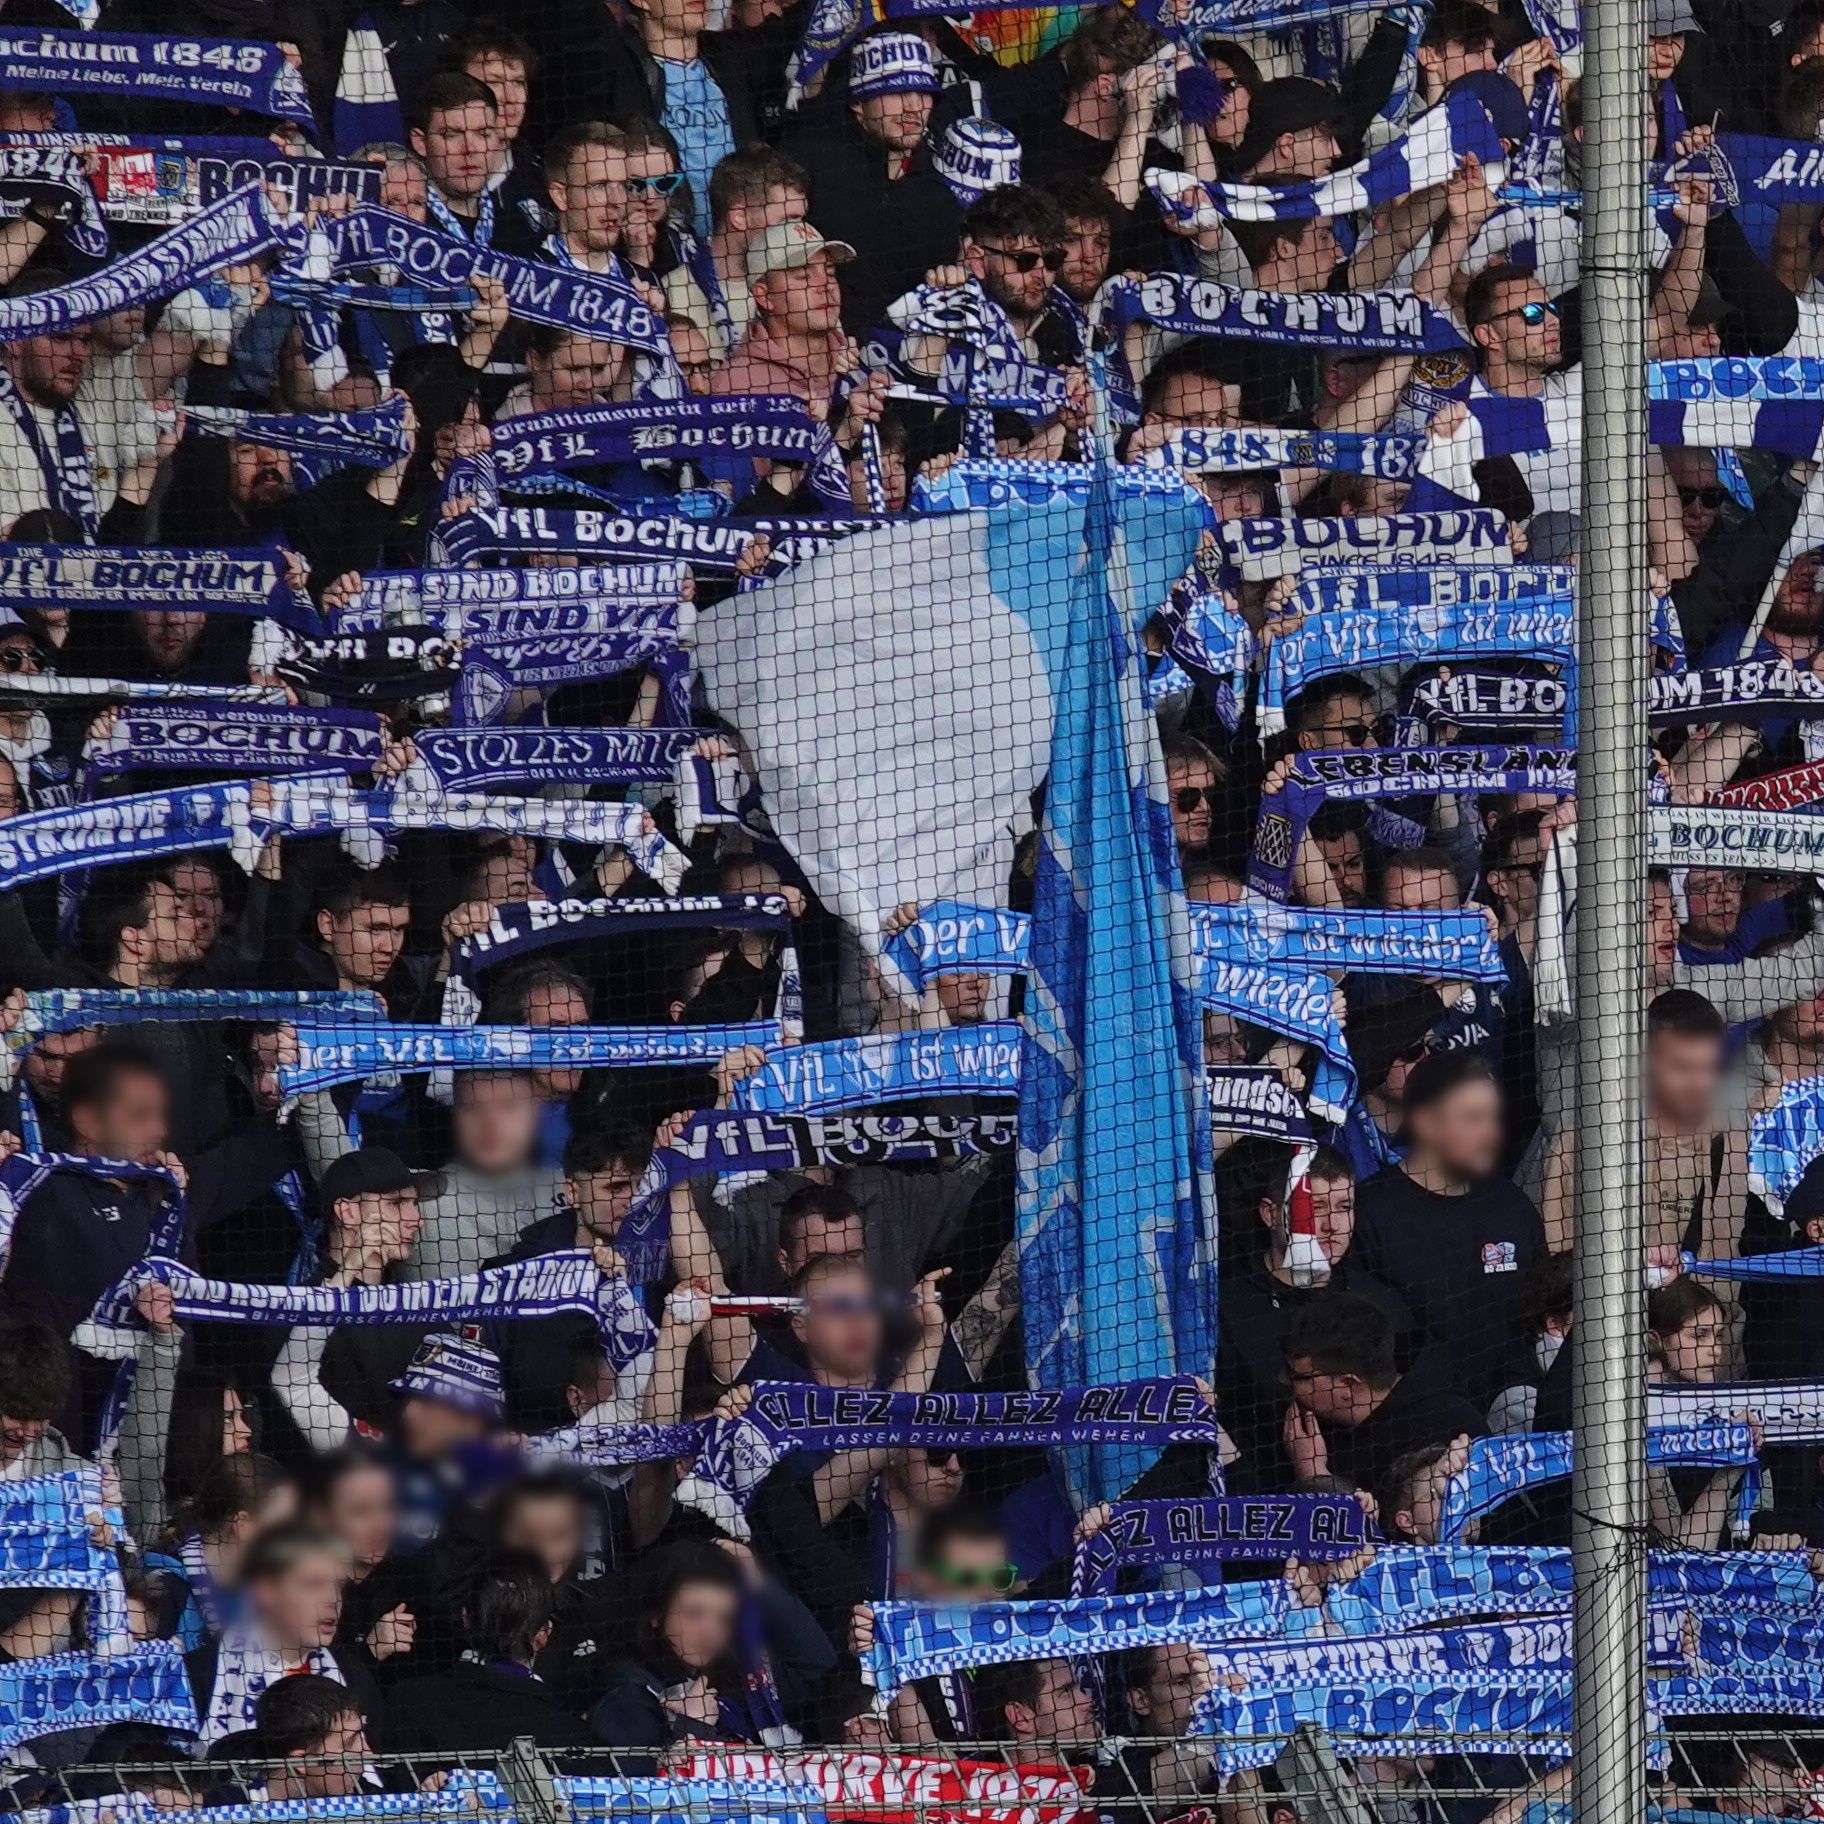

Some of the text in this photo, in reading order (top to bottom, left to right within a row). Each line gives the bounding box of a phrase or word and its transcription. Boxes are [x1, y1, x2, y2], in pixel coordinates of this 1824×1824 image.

[153, 42, 268, 73] 1848
[6, 65, 68, 81] Meine
[190, 78, 252, 99] Verein
[331, 219, 653, 337] VfL BOCHUM 1848
[1140, 276, 1428, 339] BOCHUM
[477, 508, 757, 560] VfL Bochum
[91, 560, 265, 593] BOCHUM
[422, 560, 686, 601] SIND BOCHUM
[128, 719, 384, 759] BOCHUM
[436, 732, 596, 780] STOLZES
[769, 1040, 946, 1100] VfL ist
[481, 1256, 597, 1308] STADION
[306, 1311, 377, 1326] WEISSE
[380, 1308, 453, 1325] FAHNEN
[457, 1305, 515, 1321] WEHEN
[755, 1384, 895, 1430] ALLEZ
[909, 1388, 1062, 1427] ALLEZ
[821, 1428, 906, 1446] LASSEN
[979, 1429, 1064, 1445] FAHNEN
[1068, 1427, 1148, 1444] WEHEN
[1166, 1501, 1296, 1543] ALLEZ
